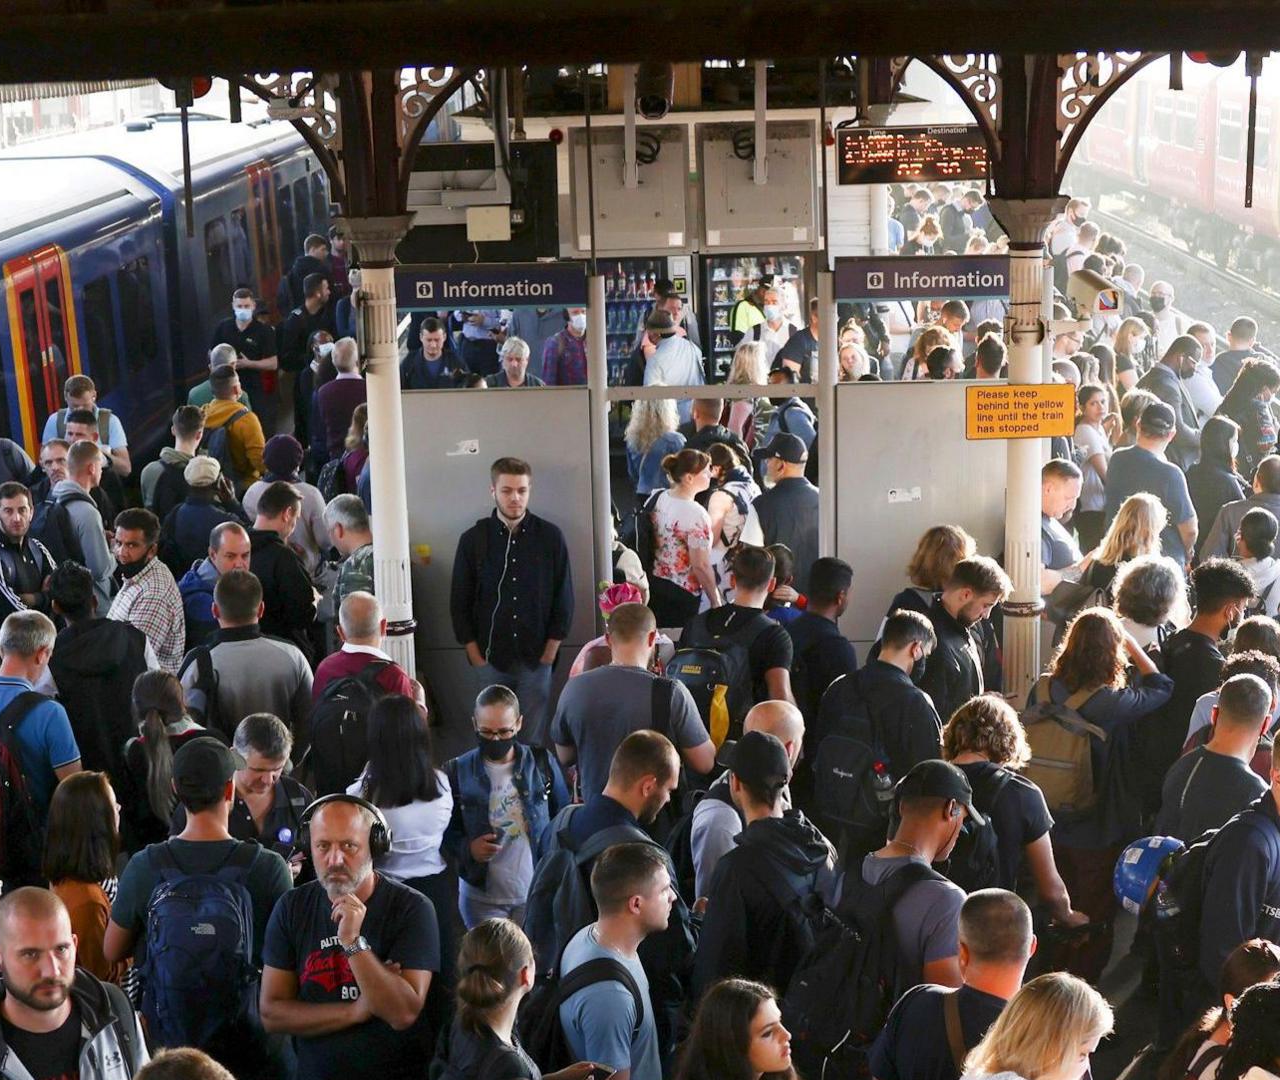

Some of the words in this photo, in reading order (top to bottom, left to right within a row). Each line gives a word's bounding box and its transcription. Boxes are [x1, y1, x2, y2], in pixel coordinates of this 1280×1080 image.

[894, 270, 1004, 289] Information
[443, 280, 553, 298] Information
[977, 390, 1009, 399] Please
[1013, 390, 1038, 399] keep
[977, 401, 1009, 410] behind
[1013, 401, 1029, 409] the
[1033, 400, 1064, 410] yellow
[977, 413, 994, 422] line
[997, 412, 1018, 421] until
[1022, 412, 1038, 420] the
[1042, 411, 1064, 420] train
[977, 424, 995, 433] has
[998, 423, 1039, 434] stopped
